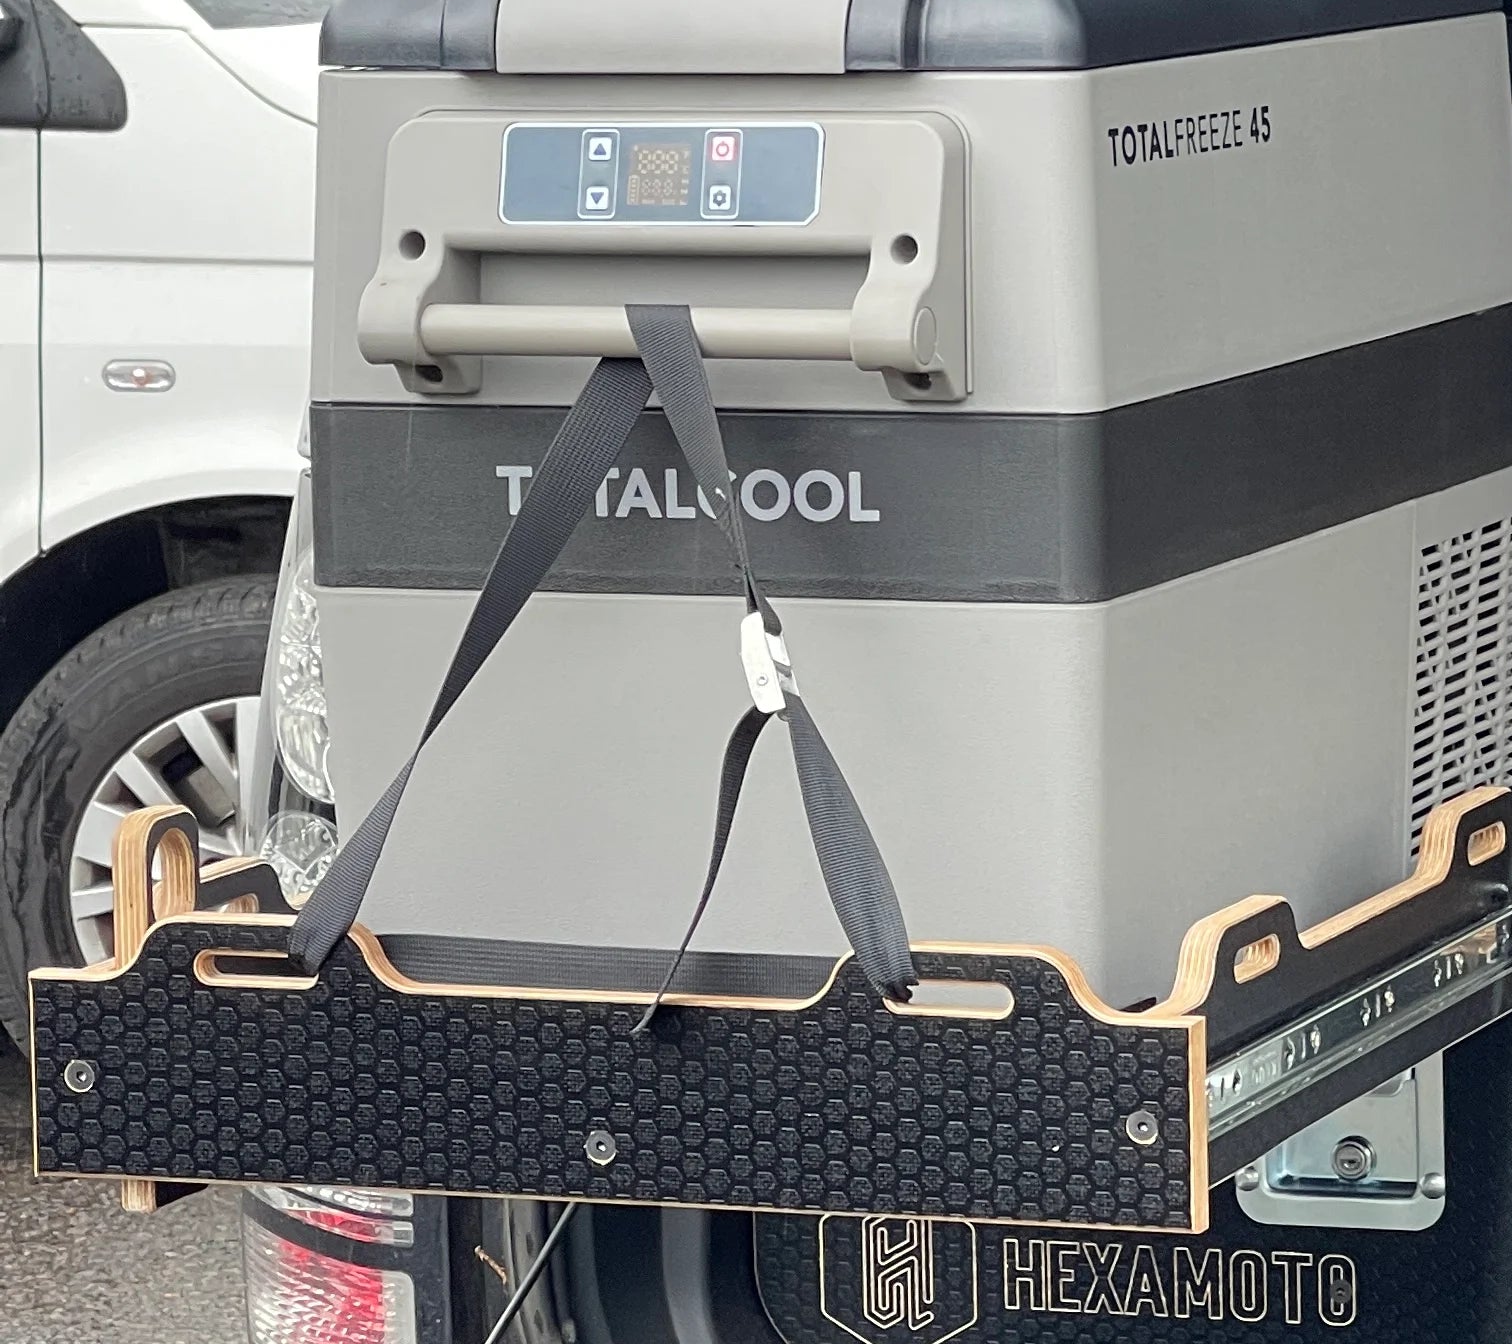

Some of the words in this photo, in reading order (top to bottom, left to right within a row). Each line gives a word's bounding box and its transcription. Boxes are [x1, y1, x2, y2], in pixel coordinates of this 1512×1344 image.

[1108, 110, 1243, 167] TOTALFREEZE
[1250, 105, 1271, 143] 45
[496, 465, 880, 522] TTALOOL
[1003, 1238, 1356, 1327] HEXAMOTO
